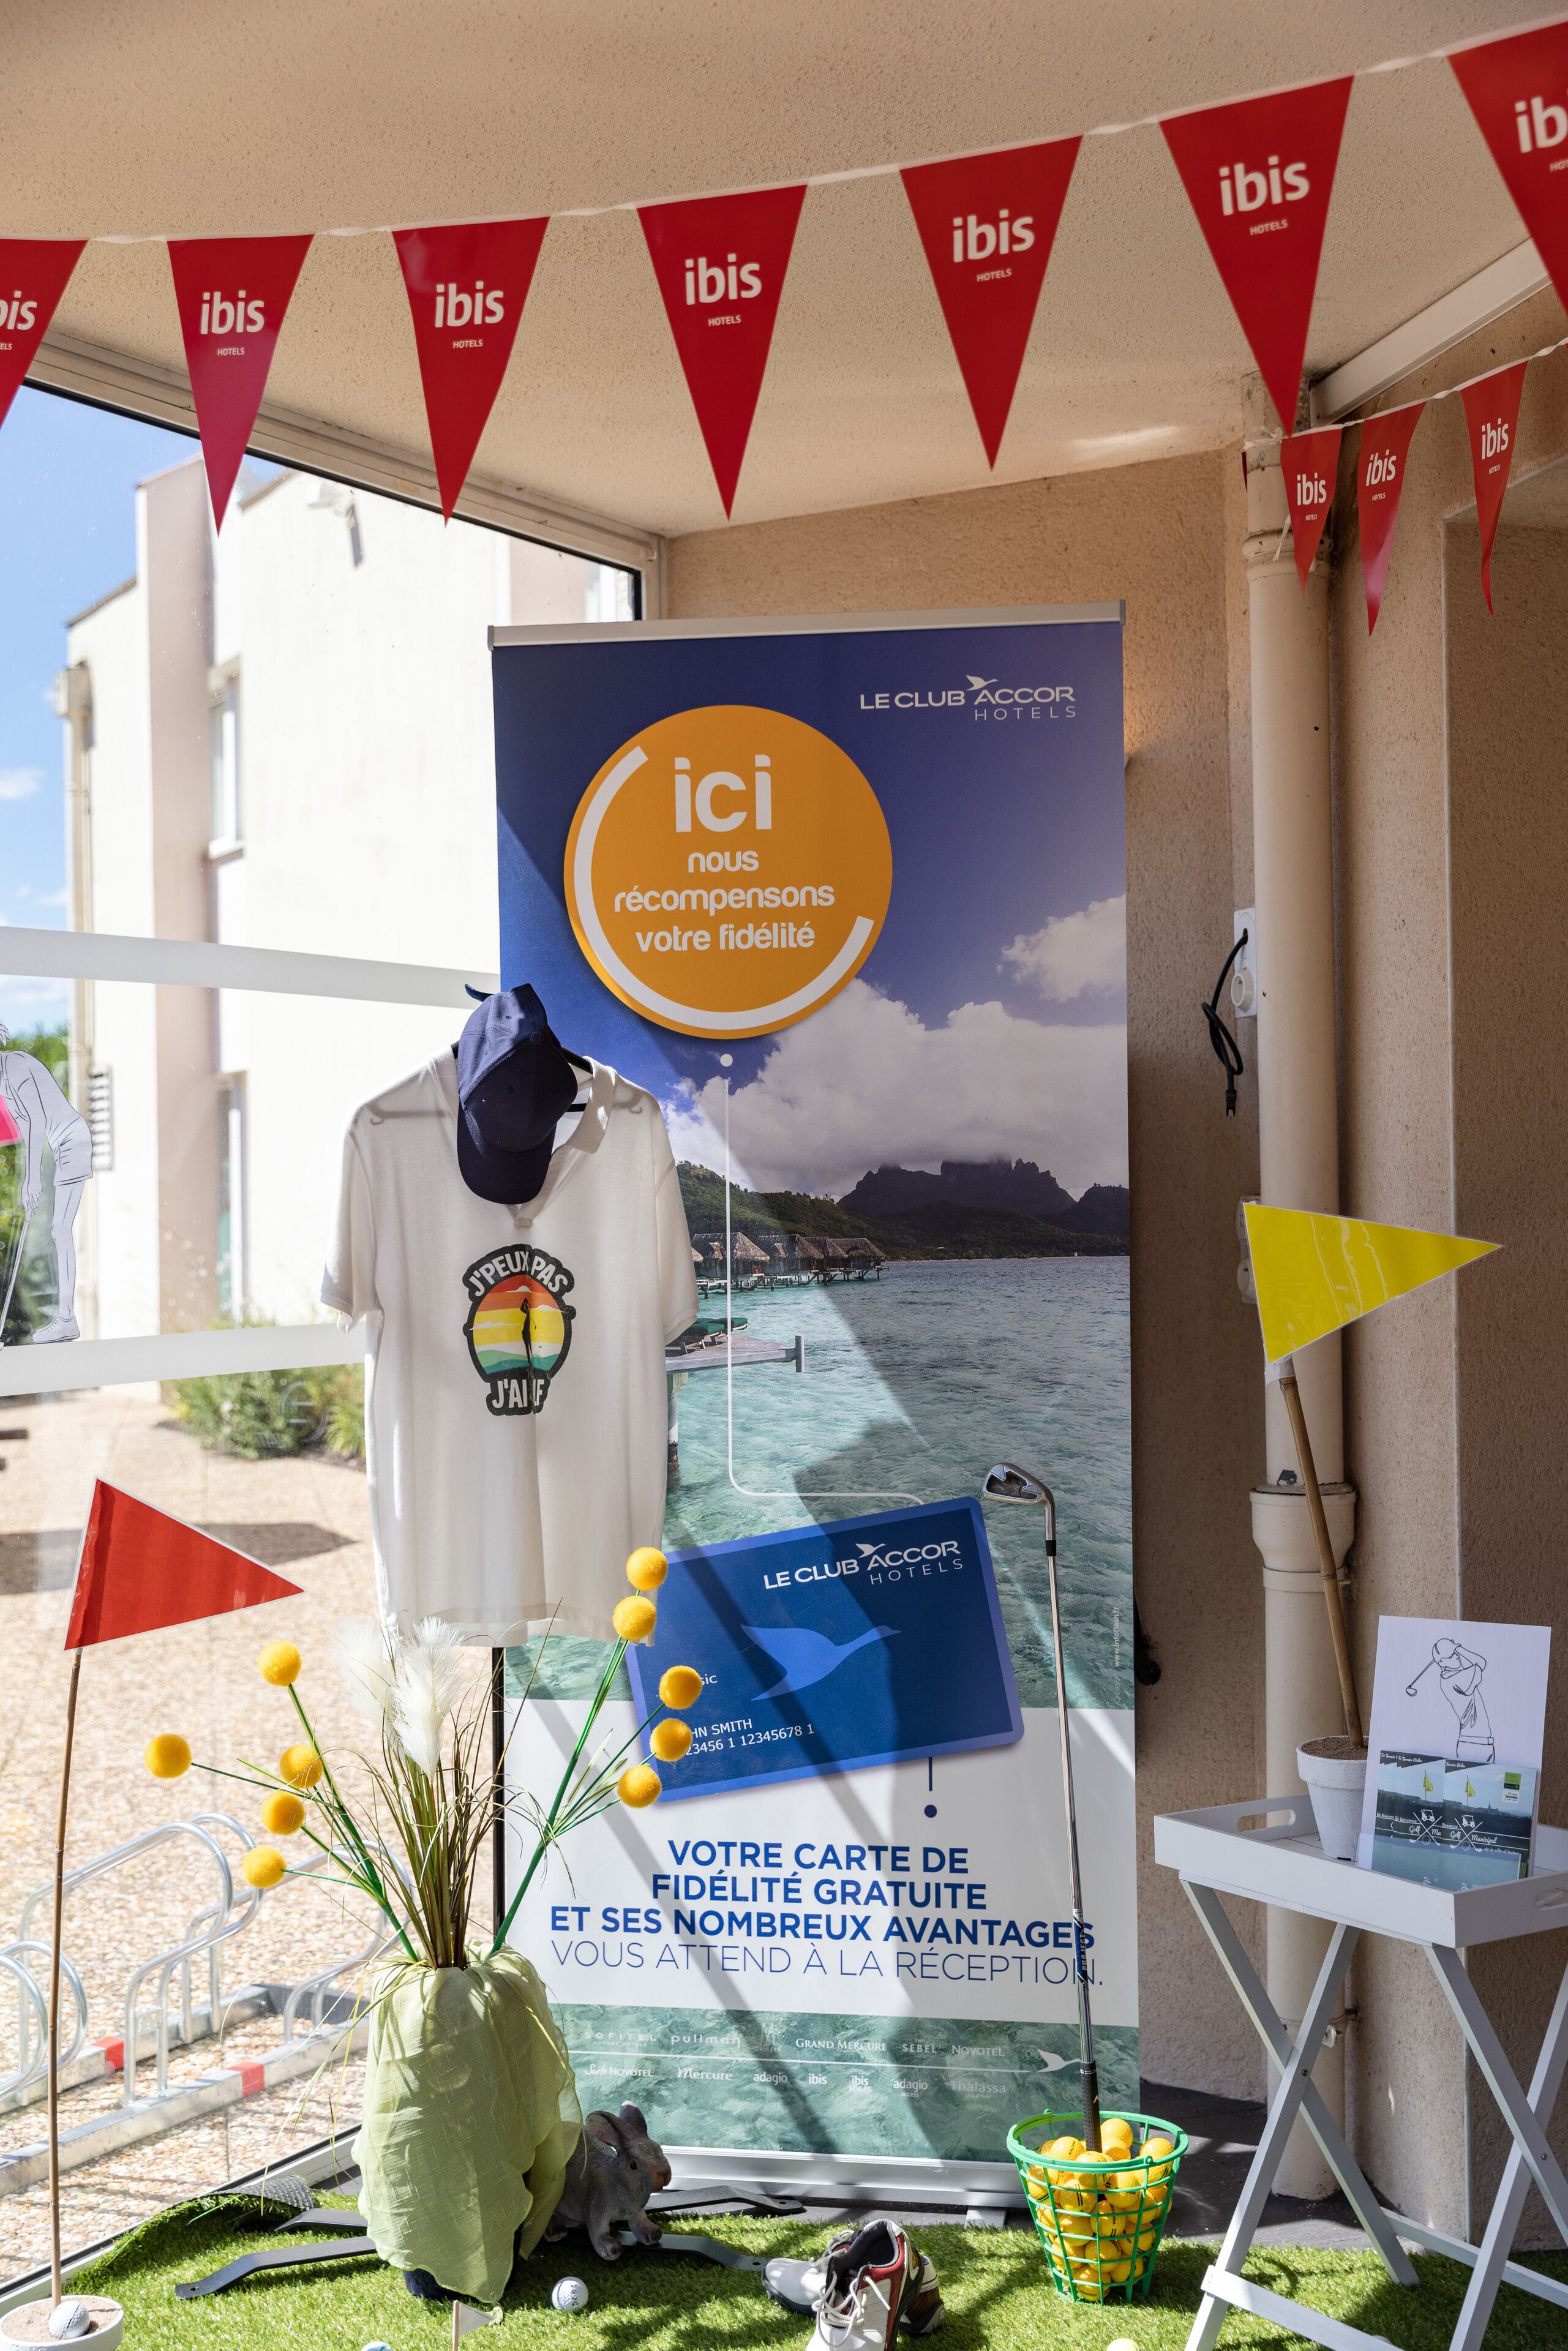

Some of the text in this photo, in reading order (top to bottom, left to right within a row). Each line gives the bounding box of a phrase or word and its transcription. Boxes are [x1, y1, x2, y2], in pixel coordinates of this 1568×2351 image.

[1514, 96, 1568, 154] ib
[1219, 155, 1310, 216] ibis
[952, 208, 1035, 263] ibis
[1249, 219, 1288, 236] HOTELS
[685, 253, 762, 306] ibis
[976, 268, 1012, 282] HOTELS
[200, 290, 265, 335] ibis
[434, 280, 505, 328] ibis
[708, 315, 741, 326] HOTELS
[217, 347, 246, 356] HOTELS
[452, 339, 484, 349] HOTELS
[1480, 418, 1509, 460] ibis
[1365, 448, 1397, 487] ibis
[1488, 463, 1501, 474] HOTELS
[1296, 472, 1327, 506] ibis
[1371, 492, 1386, 501] HOTELS
[860, 685, 1076, 710] LE CLUB ACCOR
[973, 705, 1078, 721] HOTELS
[673, 754, 773, 833] ici
[687, 850, 760, 874] nous
[614, 885, 835, 917] récompensons
[635, 920, 816, 953] votre fidélité
[468, 1251, 569, 1297] J'PEUX PAS
[492, 1378, 528, 1409] J'AI
[763, 1540, 962, 1590] LE CLUB ACCOR
[870, 1558, 963, 1586] HOTELS
[710, 1718, 753, 1736] SMITH
[685, 1723, 815, 1757] 23456 1 12345678 1
[1409, 1825, 1421, 1834] Golf
[1450, 1831, 1461, 1840] Golf
[1471, 1834, 1497, 1845] Municipal
[667, 1839, 969, 1875] VOTRE CARTE DE
[652, 1869, 988, 1911] FIDÉLITÉ GRATUITE
[550, 1905, 1095, 1949] ET SES NOMBREUX AVANTAGES
[550, 1940, 1103, 1986] VOUS ATTEND À LA RÉCEPTION.
[583, 2031, 658, 2042] SOFITEL
[670, 2033, 740, 2049] pullman
[795, 2038, 888, 2052] GRAND MERCURE
[902, 2043, 937, 2053] SEBEL
[951, 2044, 1006, 2057] NOVOTEL
[609, 2066, 655, 2077] NOVOTEL
[676, 2064, 733, 2082] Mercure
[753, 2071, 789, 2086] adagio
[808, 2072, 828, 2085] ibis
[851, 2074, 869, 2087] ibis
[892, 2078, 929, 2091] adagio
[949, 2080, 1007, 2094] Thalassa
